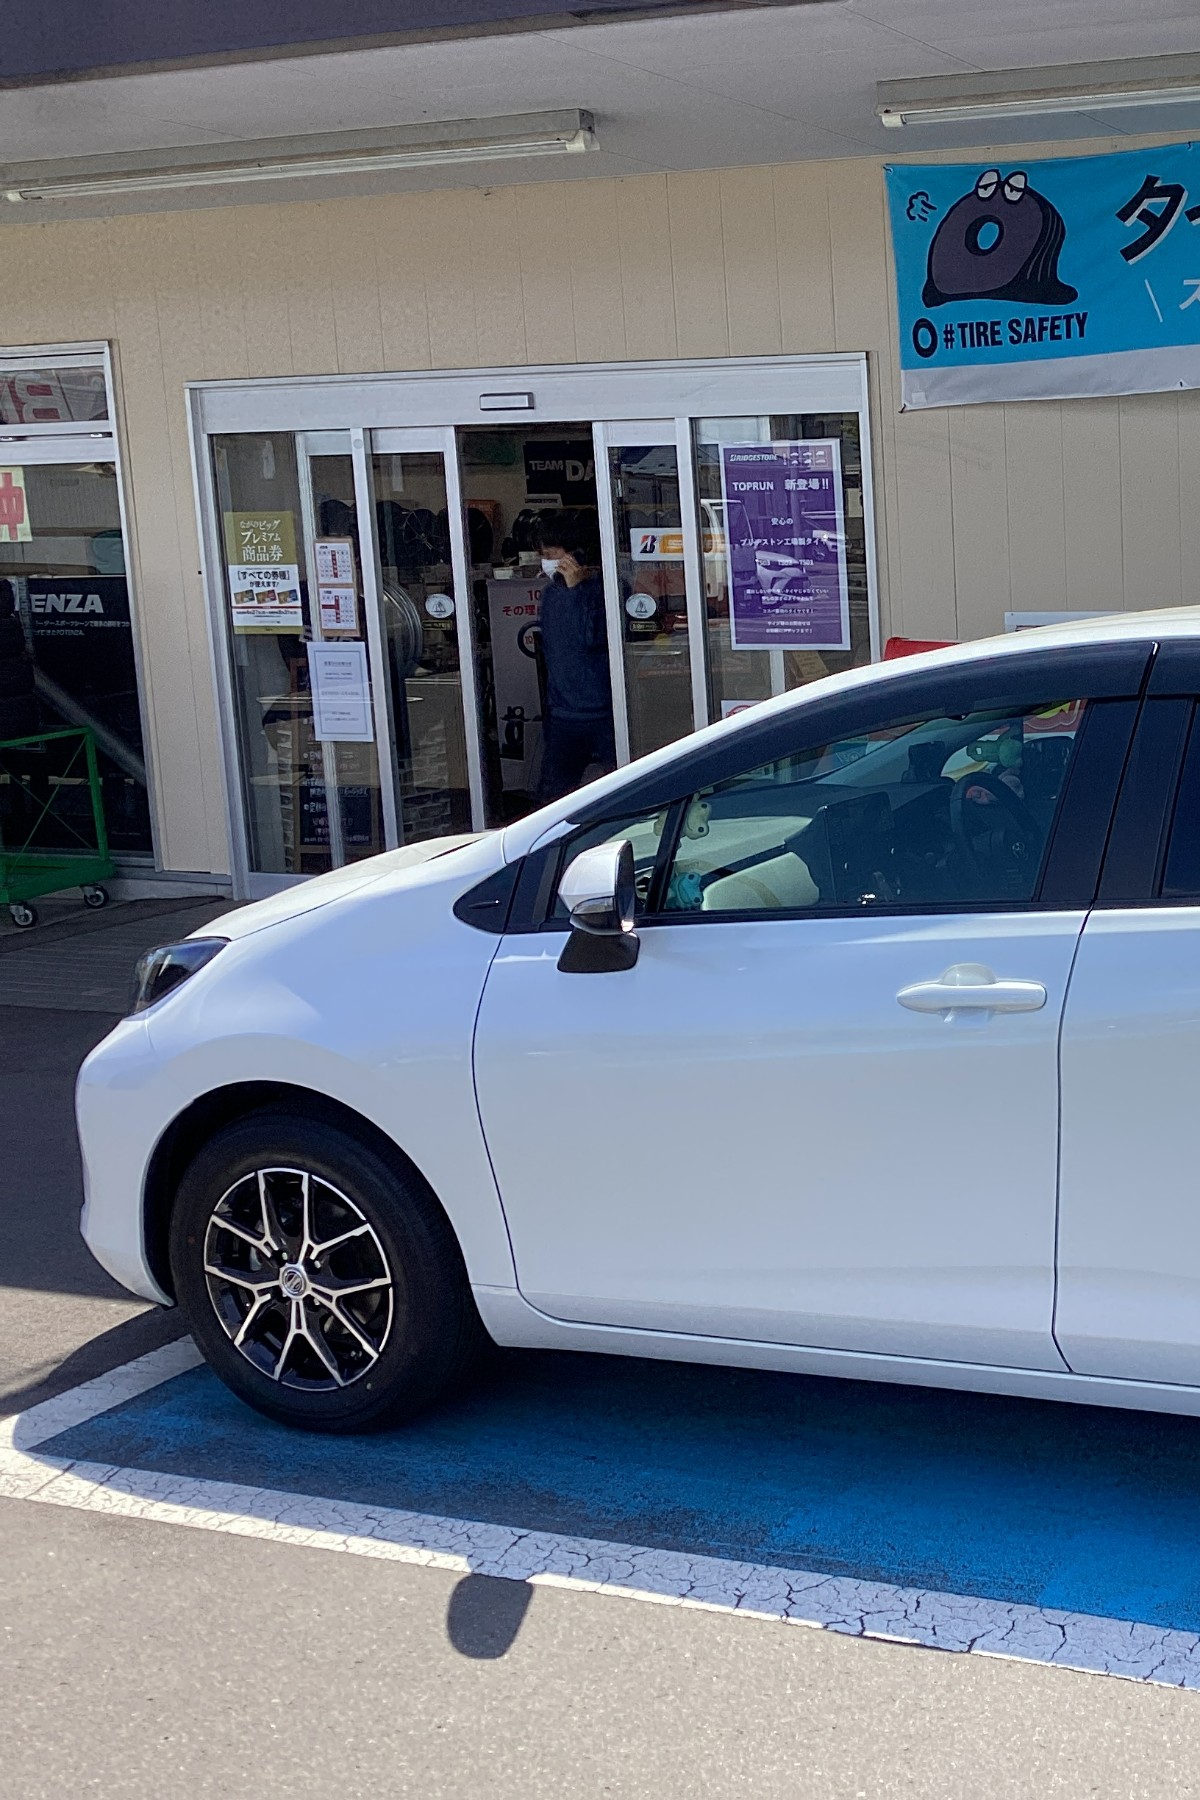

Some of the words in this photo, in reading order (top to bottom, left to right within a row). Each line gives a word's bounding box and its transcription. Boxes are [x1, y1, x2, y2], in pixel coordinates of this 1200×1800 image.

[942, 320, 1003, 349] #TIRE
[1008, 312, 1089, 344] SAFETY
[730, 452, 777, 462] BRIDGESTONE
[528, 460, 564, 471] TEAM
[732, 481, 774, 491] TOPRUN
[240, 519, 281, 531] ながのビッグ
[771, 517, 794, 526] 安心の
[240, 528, 281, 546] プレミアム
[242, 544, 284, 562] 商品券
[502, 604, 542, 616] その理
